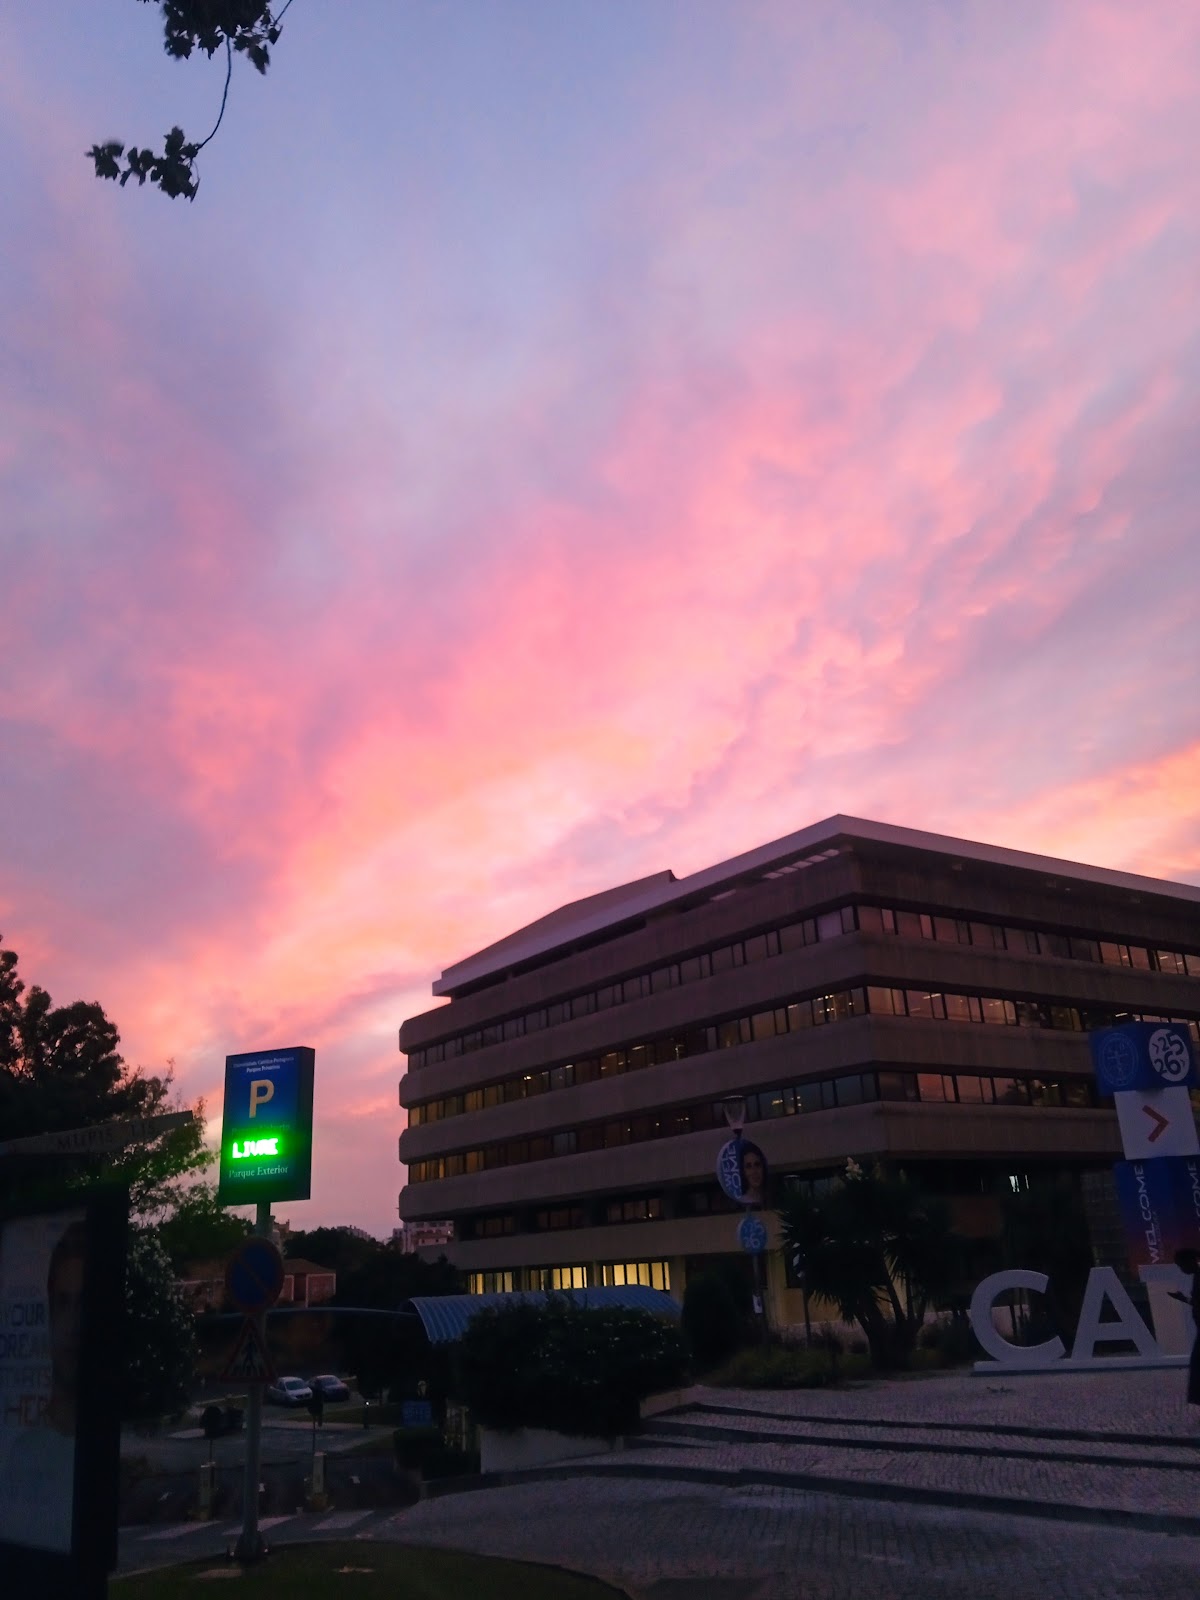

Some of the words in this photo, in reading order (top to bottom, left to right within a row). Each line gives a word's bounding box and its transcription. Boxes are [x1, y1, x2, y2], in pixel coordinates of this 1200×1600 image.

[249, 1079, 275, 1119] P
[228, 1169, 256, 1180] Parque
[256, 1164, 289, 1176] Exterior
[1134, 1164, 1160, 1264] WELCOME
